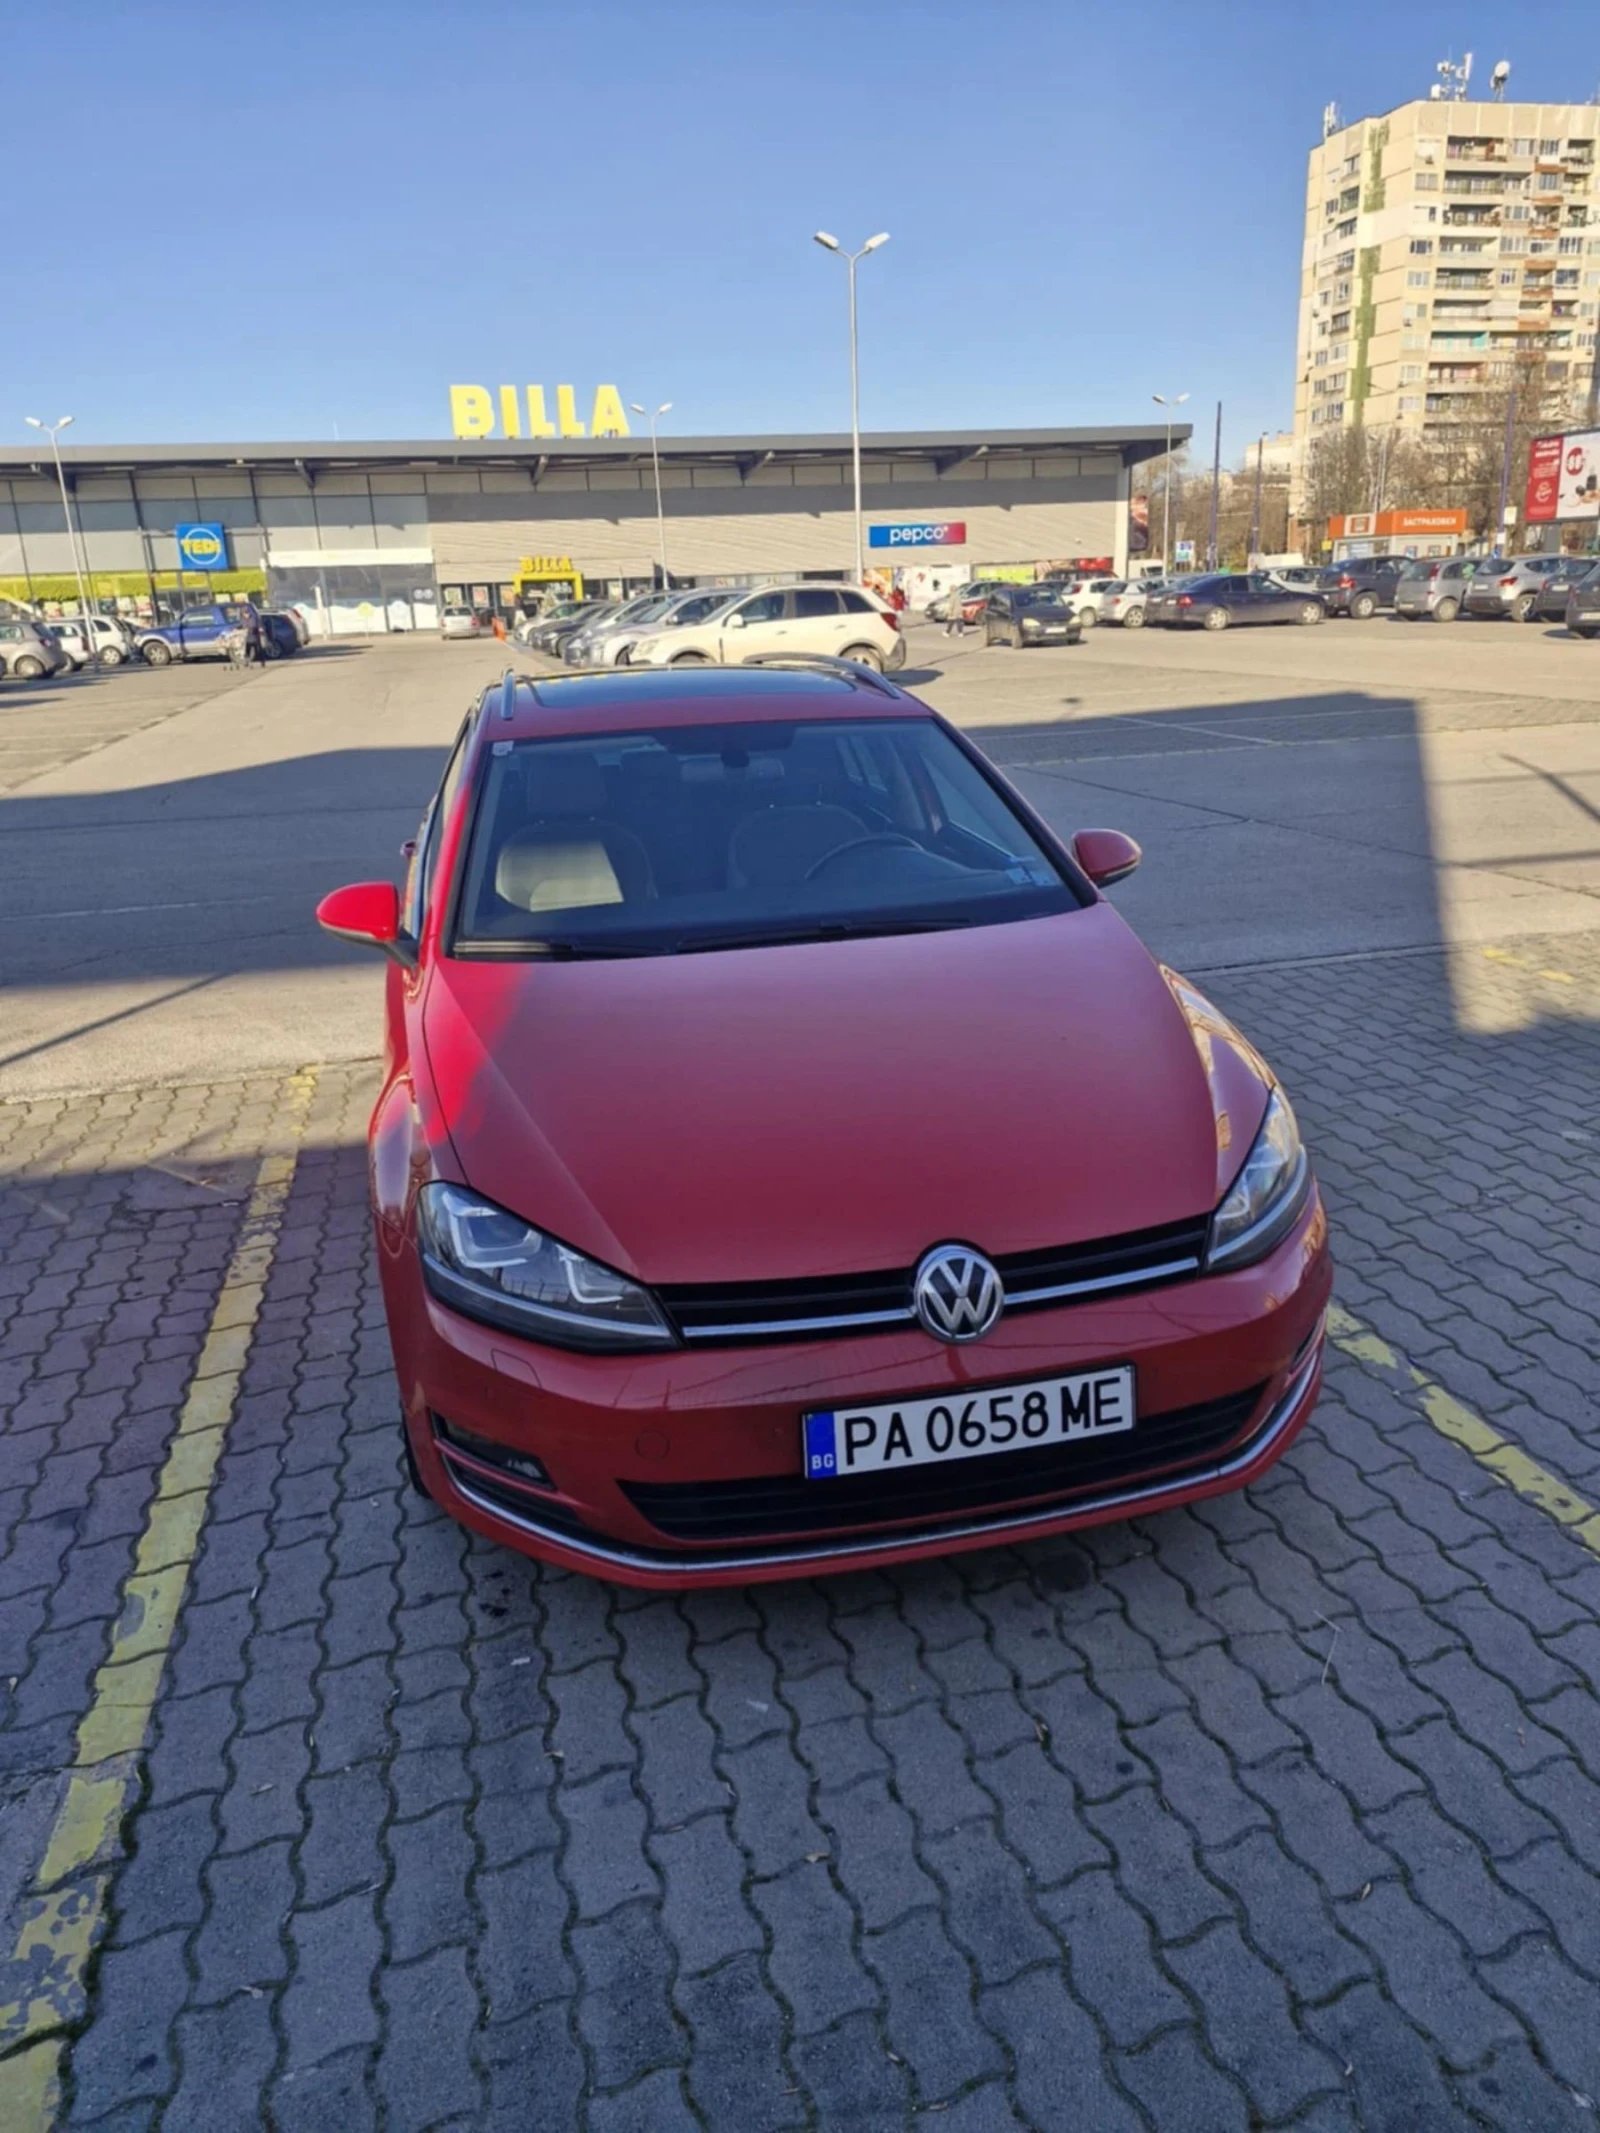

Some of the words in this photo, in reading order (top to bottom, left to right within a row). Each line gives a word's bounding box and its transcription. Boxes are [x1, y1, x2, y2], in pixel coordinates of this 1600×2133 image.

[450, 384, 630, 437] BILLA
[890, 527, 944, 544] pepco
[522, 556, 572, 571] BILLA
[844, 1412, 913, 1466] PA
[926, 1391, 1050, 1453] 0658
[1061, 1377, 1124, 1433] ME
[812, 1454, 835, 1470] BG
